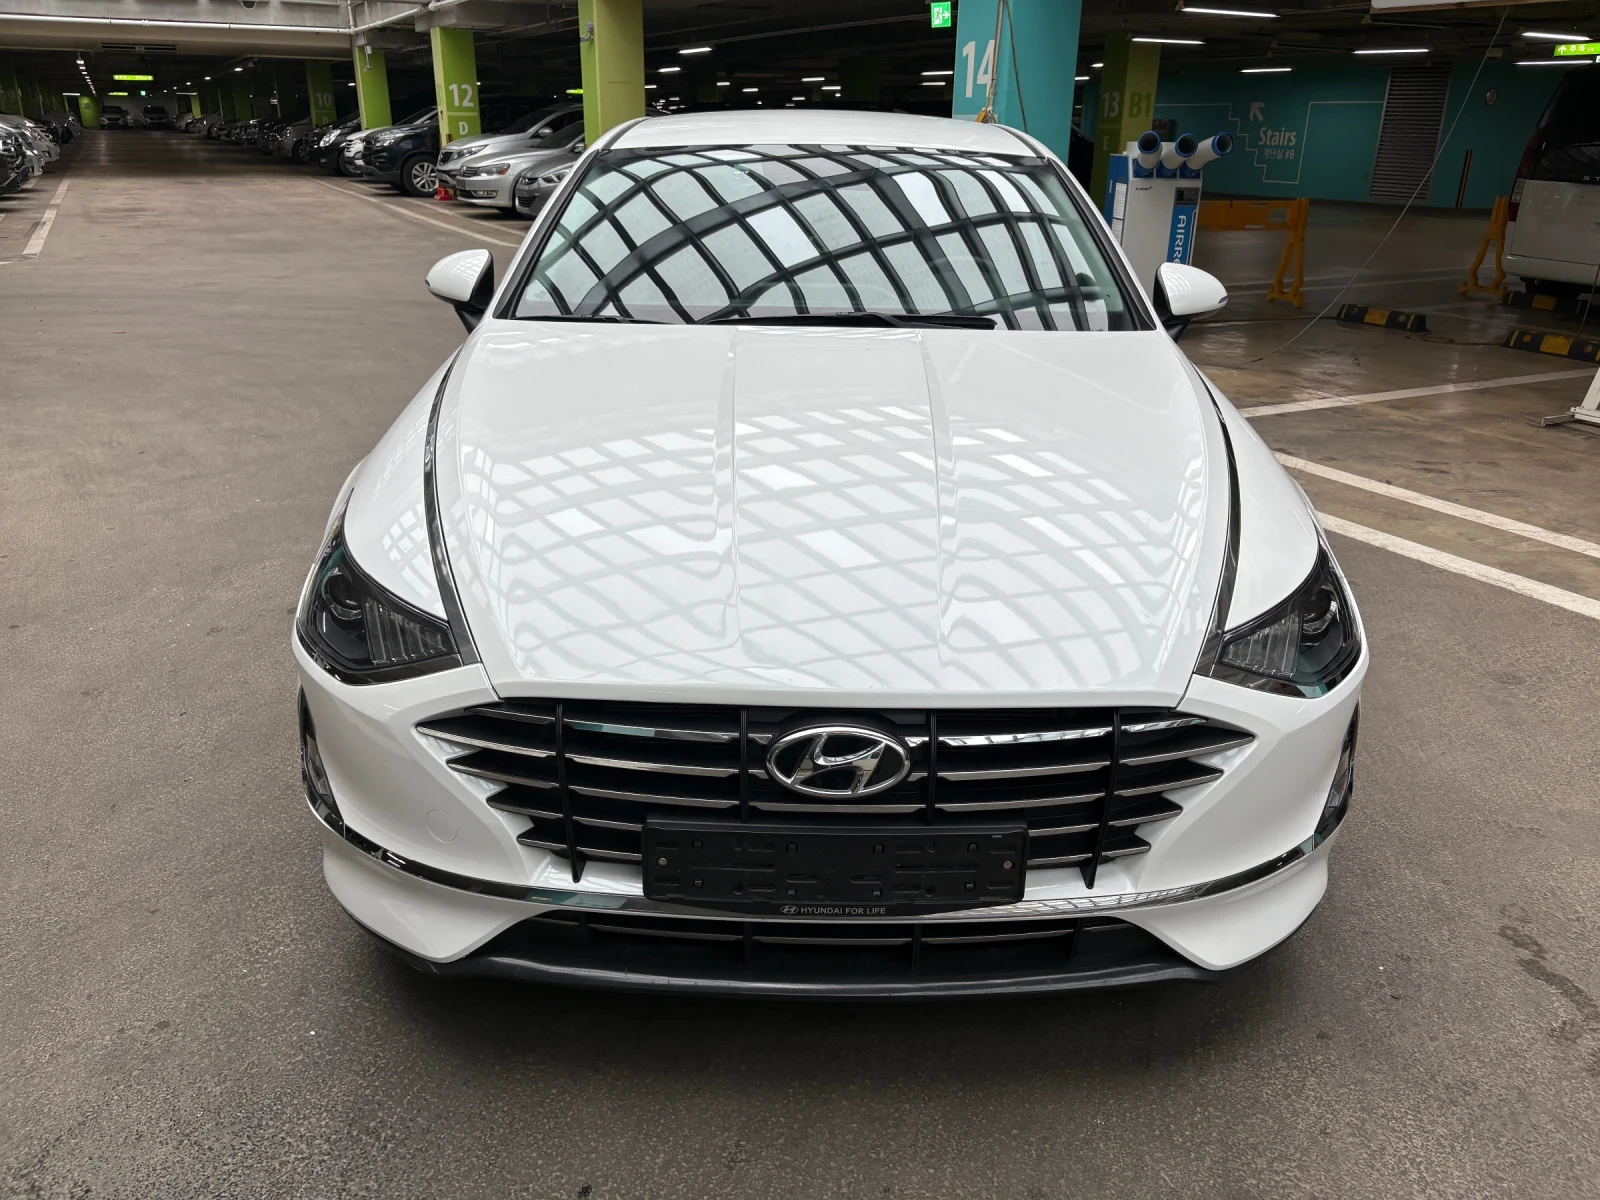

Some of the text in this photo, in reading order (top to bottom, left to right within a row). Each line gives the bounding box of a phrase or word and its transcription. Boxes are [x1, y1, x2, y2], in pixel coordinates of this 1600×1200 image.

[962, 39, 996, 98] 14
[315, 92, 331, 107] 10
[448, 83, 474, 107] 12
[1102, 91, 1120, 118] 13
[1129, 91, 1152, 118] B1
[459, 121, 469, 135] D
[1258, 126, 1297, 147] Stairs
[1103, 135, 1110, 150] E
[1285, 149, 1295, 160] #6
[800, 906, 887, 915] HYUNDAI FOR LIFE
